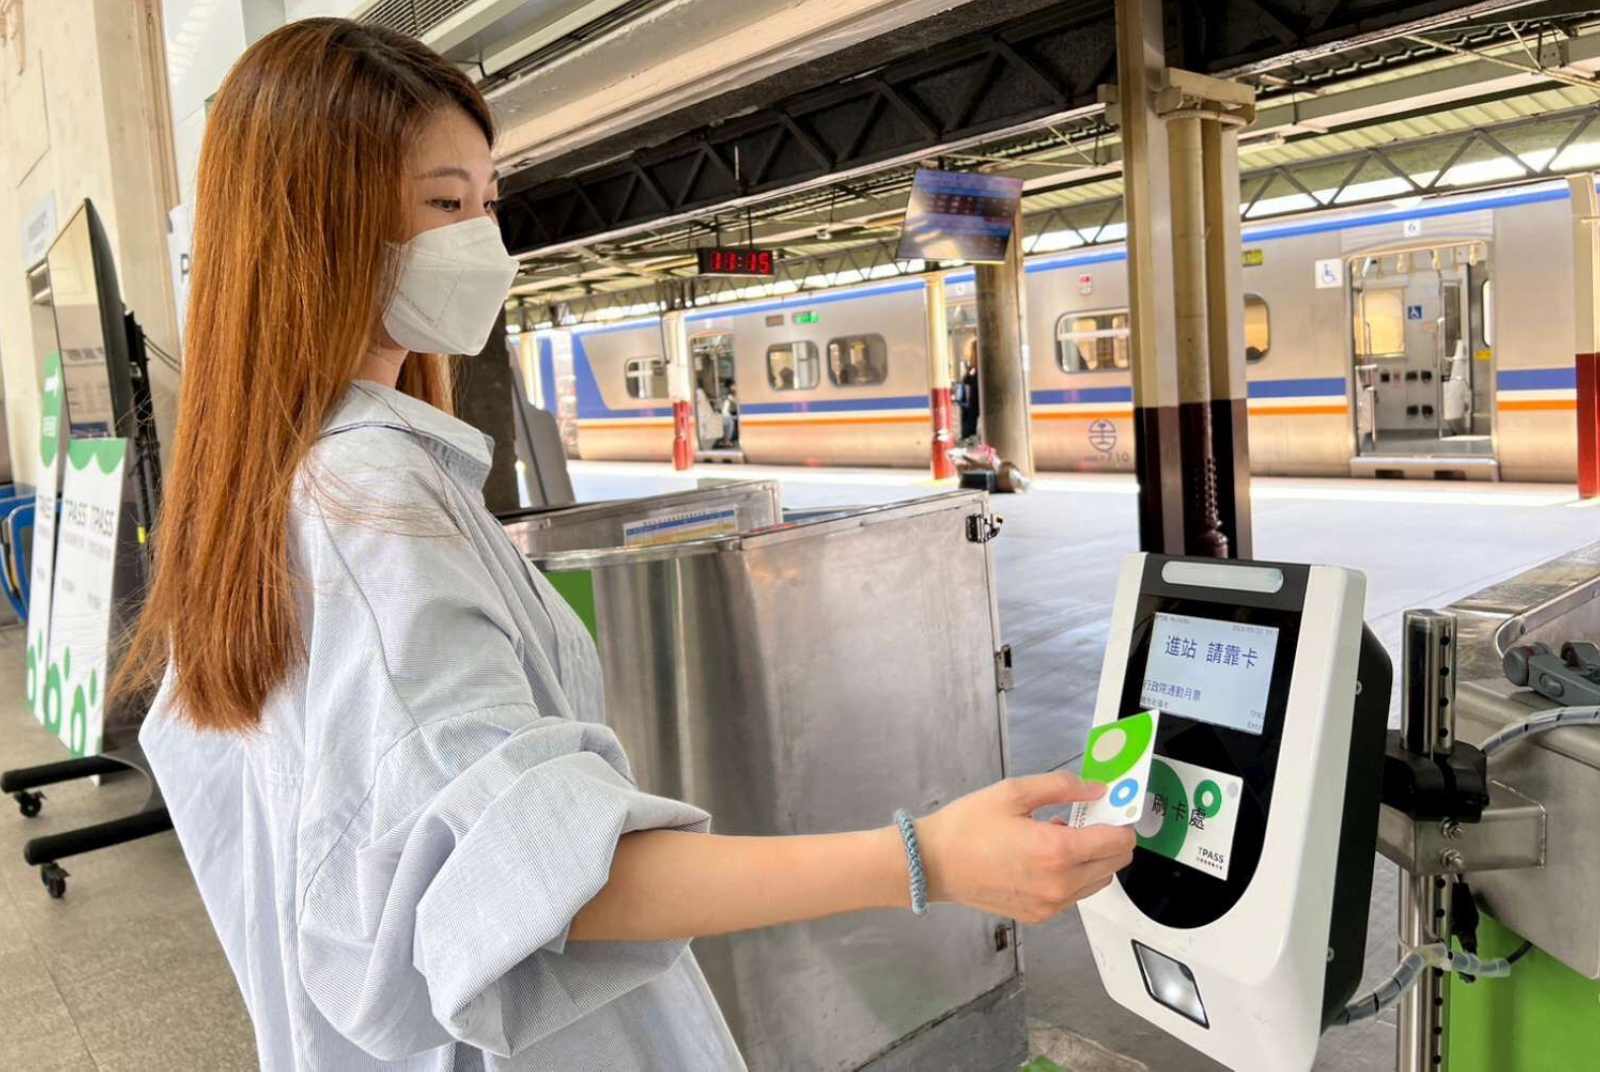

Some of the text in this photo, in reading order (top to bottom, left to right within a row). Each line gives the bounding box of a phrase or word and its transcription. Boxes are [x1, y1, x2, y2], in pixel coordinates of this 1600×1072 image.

[1164, 635, 1259, 669] 進站 請靠卡
[1152, 793, 1207, 831] 刷卡處
[1199, 847, 1225, 864] TPASS
